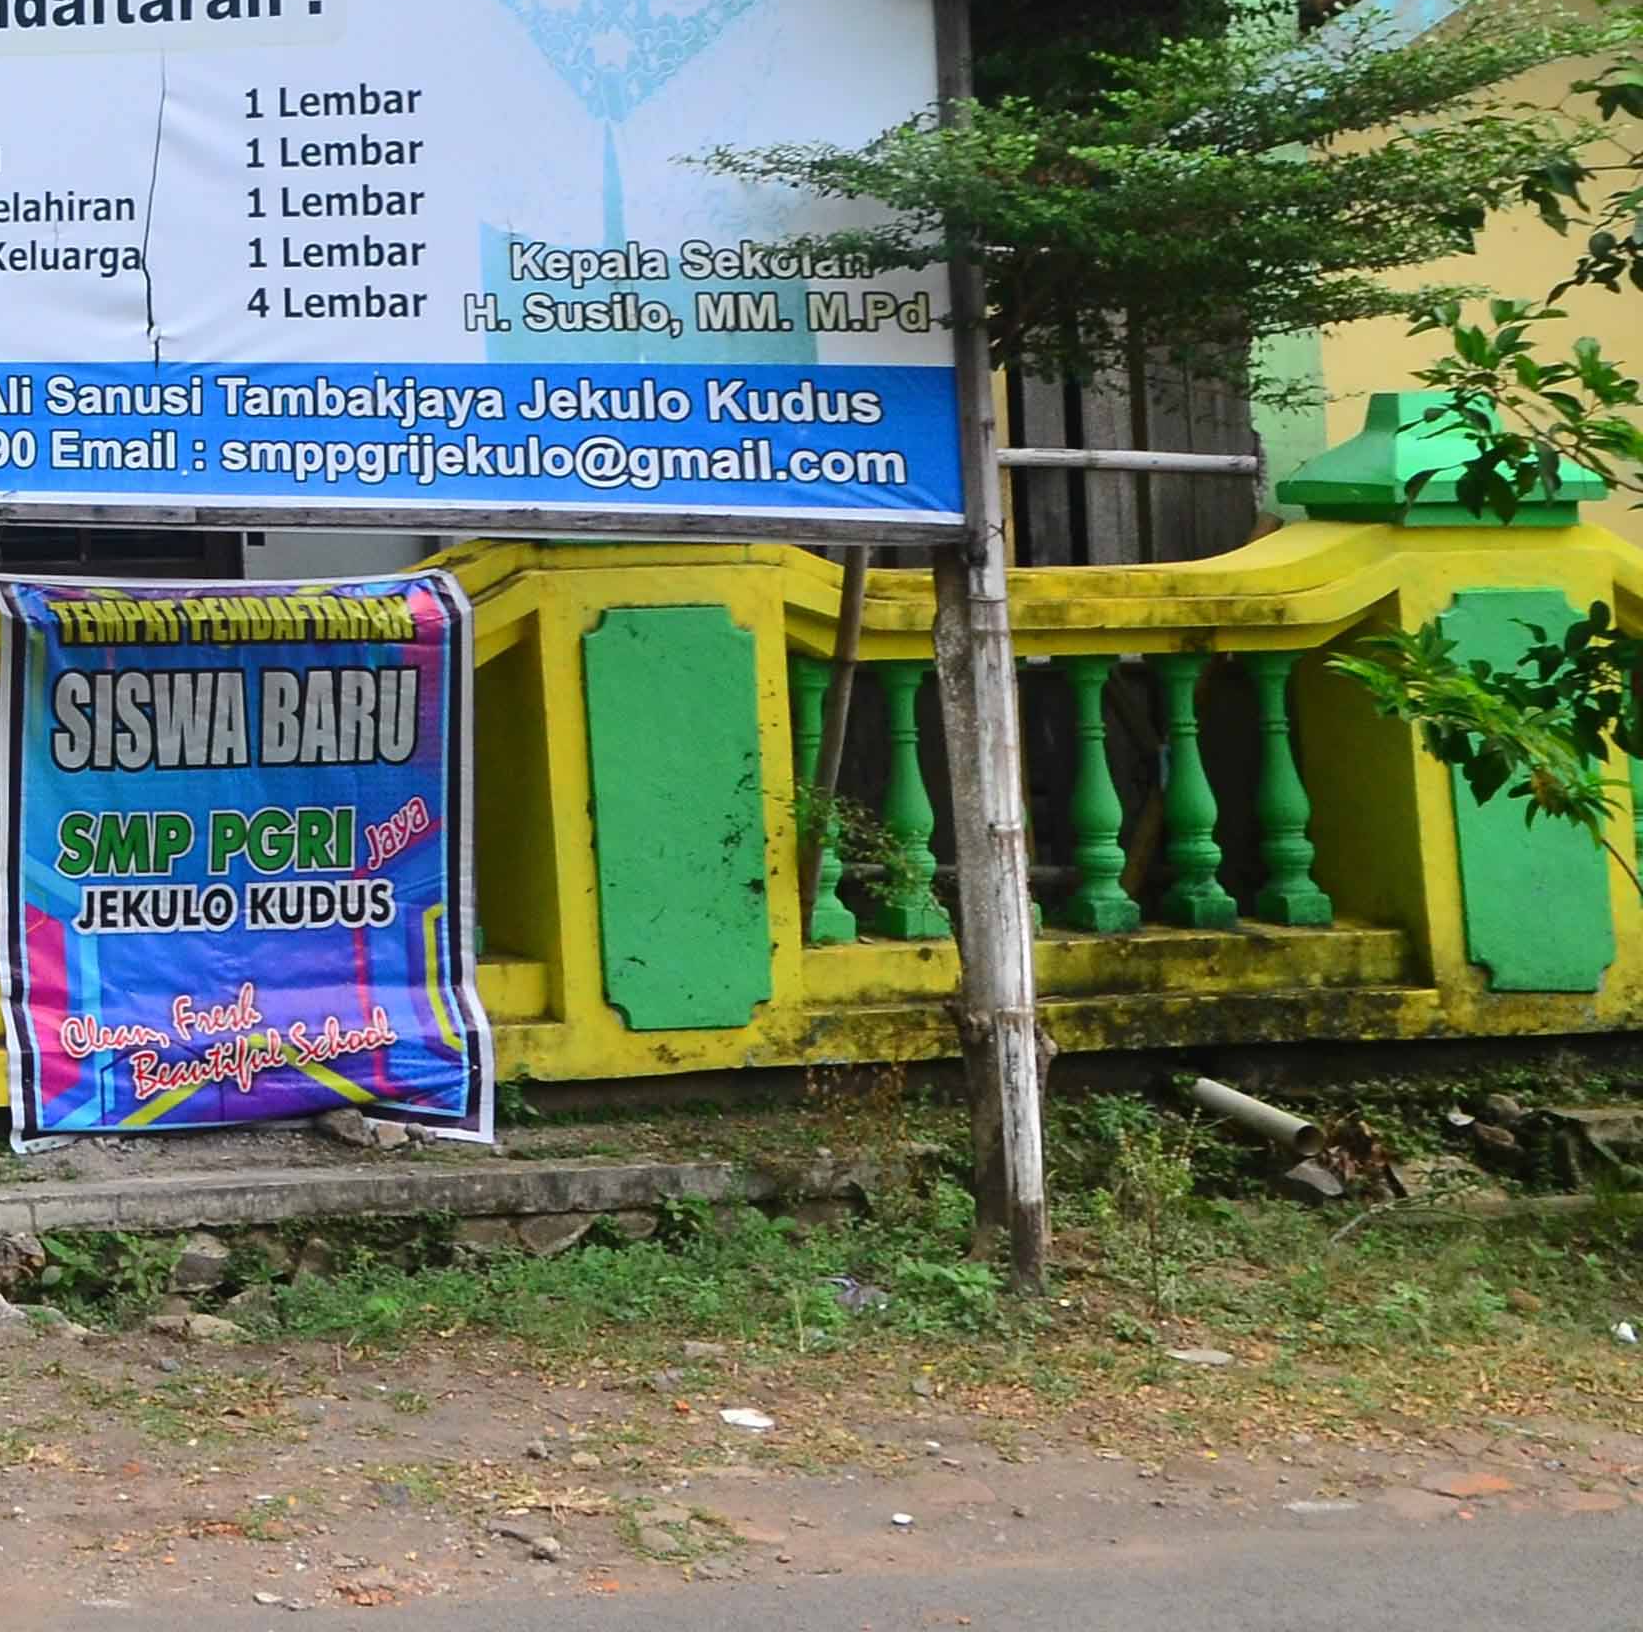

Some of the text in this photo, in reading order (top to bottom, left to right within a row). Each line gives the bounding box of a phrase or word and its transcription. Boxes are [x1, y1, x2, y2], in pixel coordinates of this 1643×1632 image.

[246, 84, 422, 119] 1 Lembar
[246, 134, 423, 168] 1 Lembar
[247, 185, 425, 218] 1 Lembar
[248, 235, 427, 269] 1 Lembar
[510, 240, 667, 289] Kepala
[247, 286, 427, 319] 4 Lembar
[464, 292, 931, 338] H. Susilo, MM. M.Pd
[46, 378, 202, 416] Sanusi
[217, 377, 504, 427] Tambakjaya
[518, 379, 691, 423] Jekulo
[706, 379, 883, 425] Kudus
[50, 429, 176, 471] Email
[220, 434, 908, 489] smppgrijekulo@gmail.com
[48, 595, 416, 645] TEMPAT PENDAFTARAN
[50, 666, 419, 773] SISWA BARU
[55, 796, 429, 877] SMP PGRI Jaya
[74, 879, 394, 935] JEKULO KUDUS
[60, 981, 262, 1058] Clean, Fresh
[131, 1006, 396, 1100] Beautiful School
